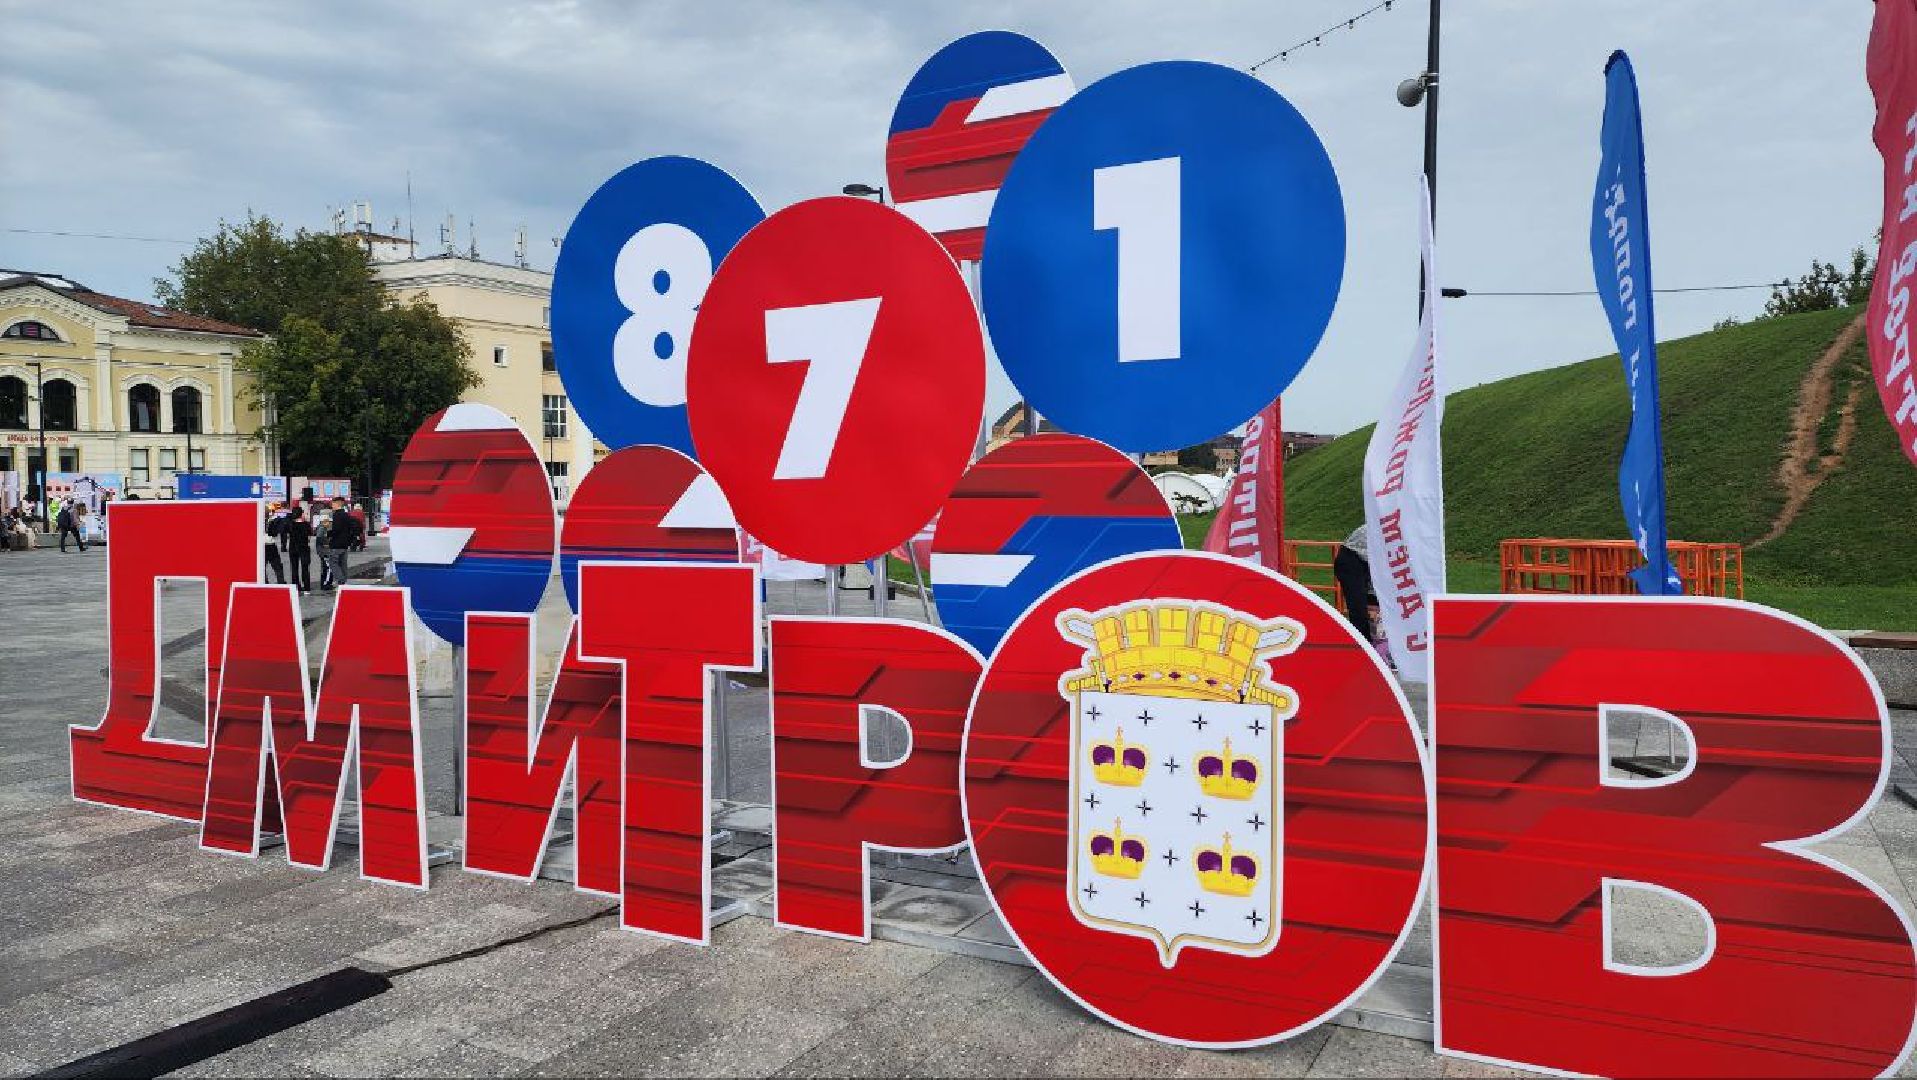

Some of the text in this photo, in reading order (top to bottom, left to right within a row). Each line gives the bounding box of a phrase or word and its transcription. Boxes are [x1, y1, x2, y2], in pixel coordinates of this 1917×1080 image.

[613, 156, 1182, 480] 8 7 1
[70, 498, 1917, 1080] ДМИТРОВ
